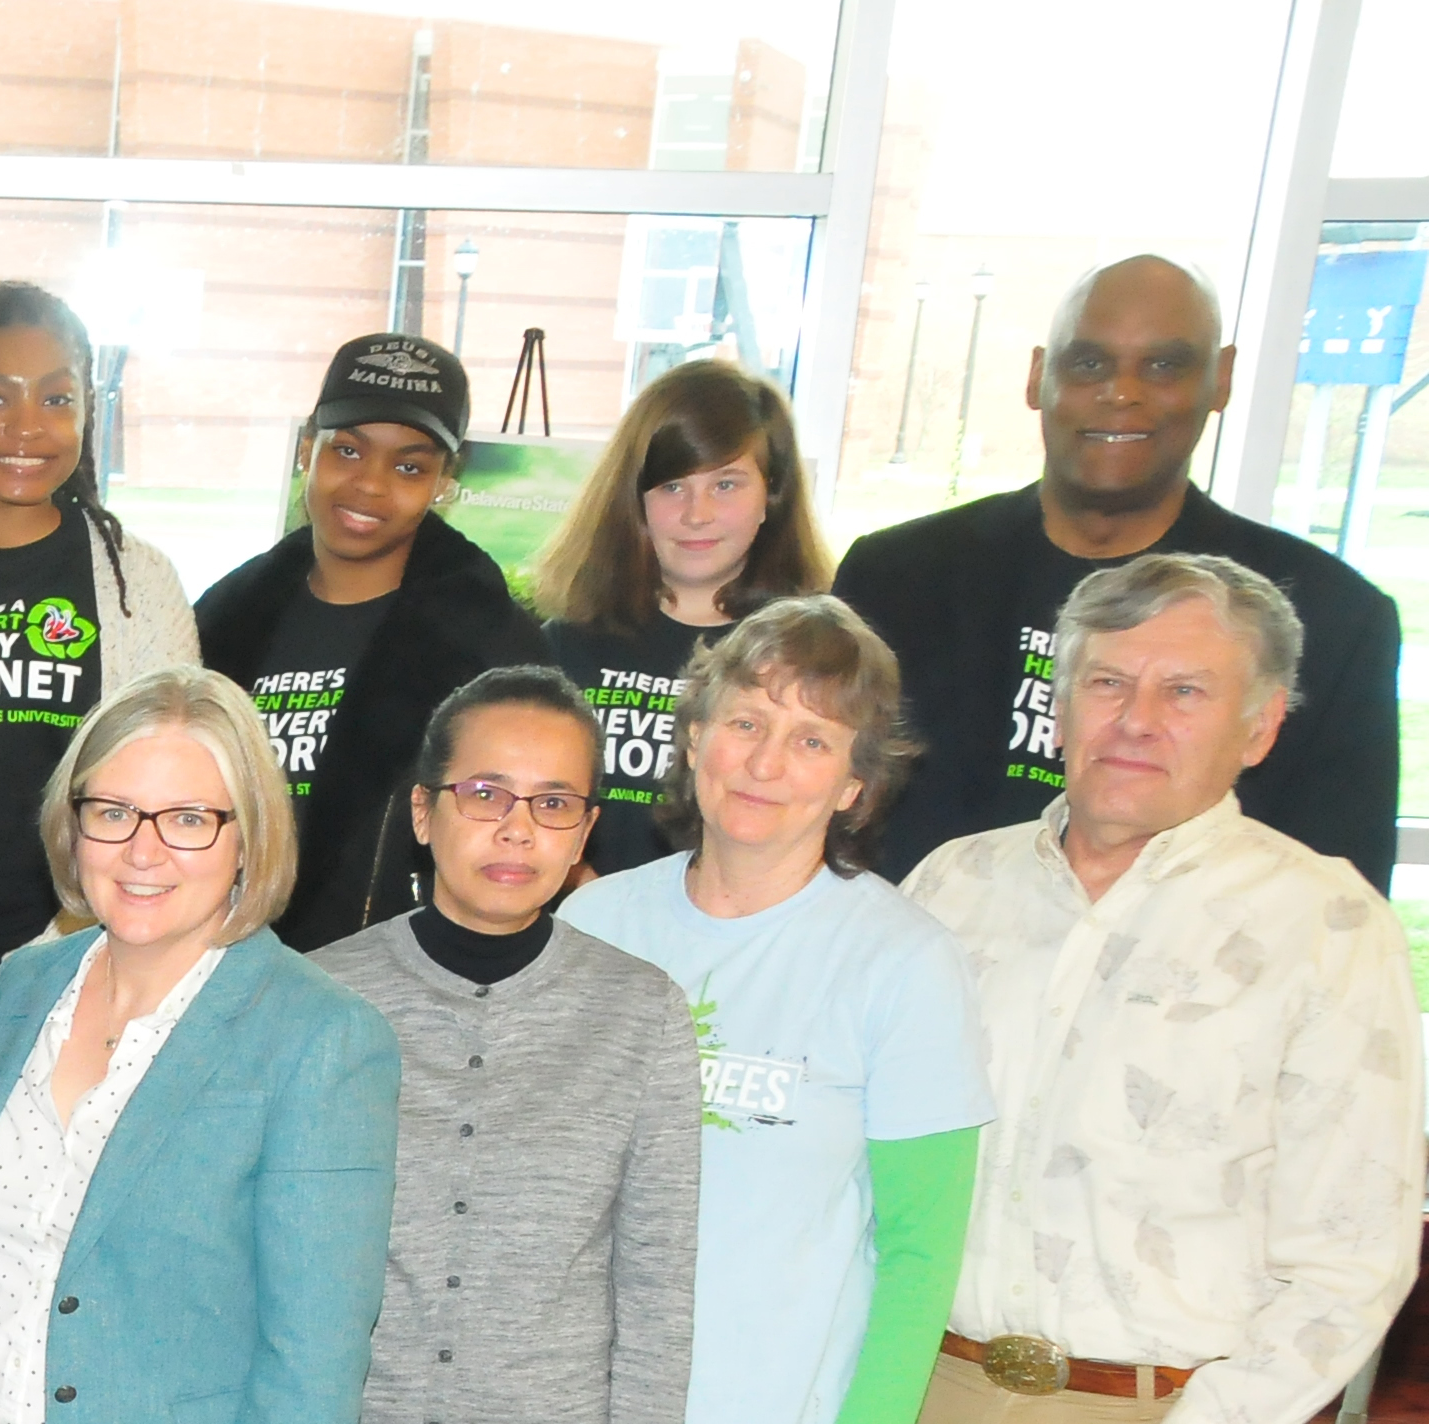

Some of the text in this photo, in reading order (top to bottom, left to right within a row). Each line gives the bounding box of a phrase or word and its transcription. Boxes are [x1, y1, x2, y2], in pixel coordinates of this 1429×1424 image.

[11, 599, 26, 613] A
[600, 668, 688, 696] THERE
[605, 708, 676, 741] EVE
[700, 1058, 791, 1113] REES
